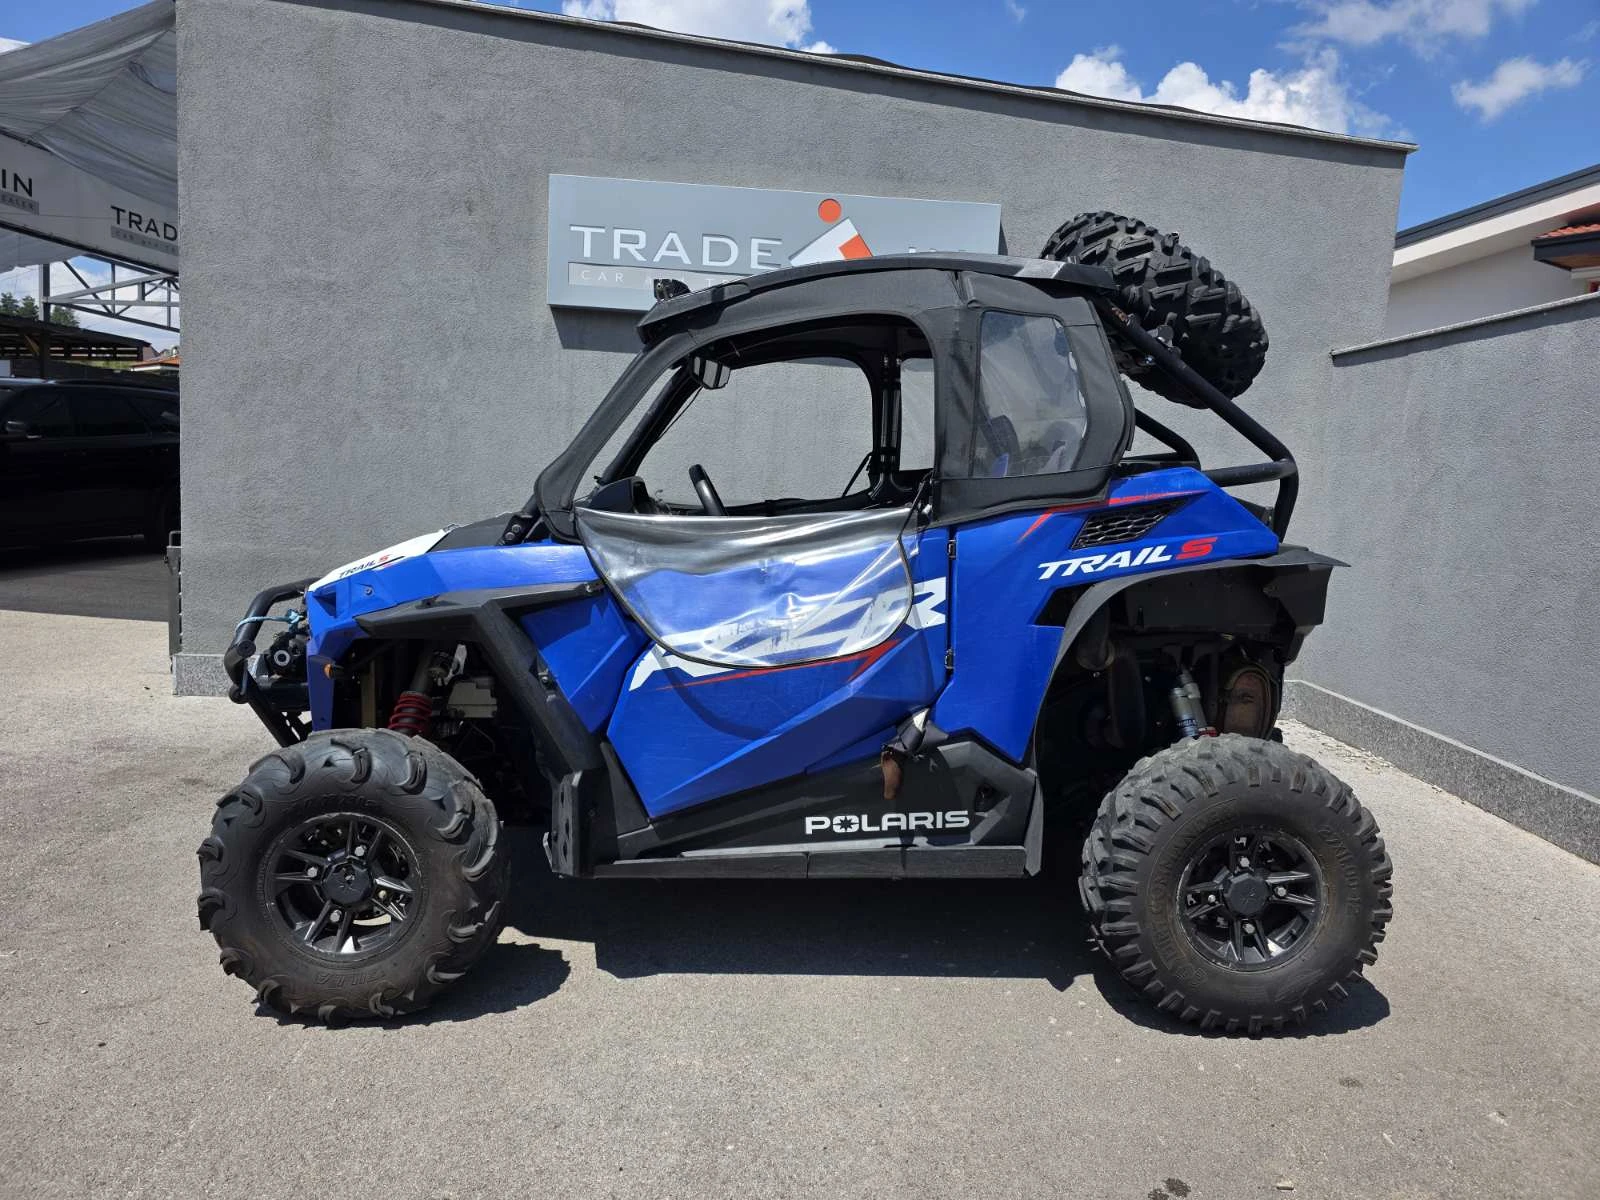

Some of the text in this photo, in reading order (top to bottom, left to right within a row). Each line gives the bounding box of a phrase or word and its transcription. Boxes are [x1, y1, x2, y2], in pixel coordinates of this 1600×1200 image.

[569, 223, 782, 271] TRADE
[580, 269, 624, 284] CAR
[339, 560, 376, 579] TRAIL
[1037, 537, 1218, 581] TRAIL S
[804, 810, 970, 836] POLARIS
